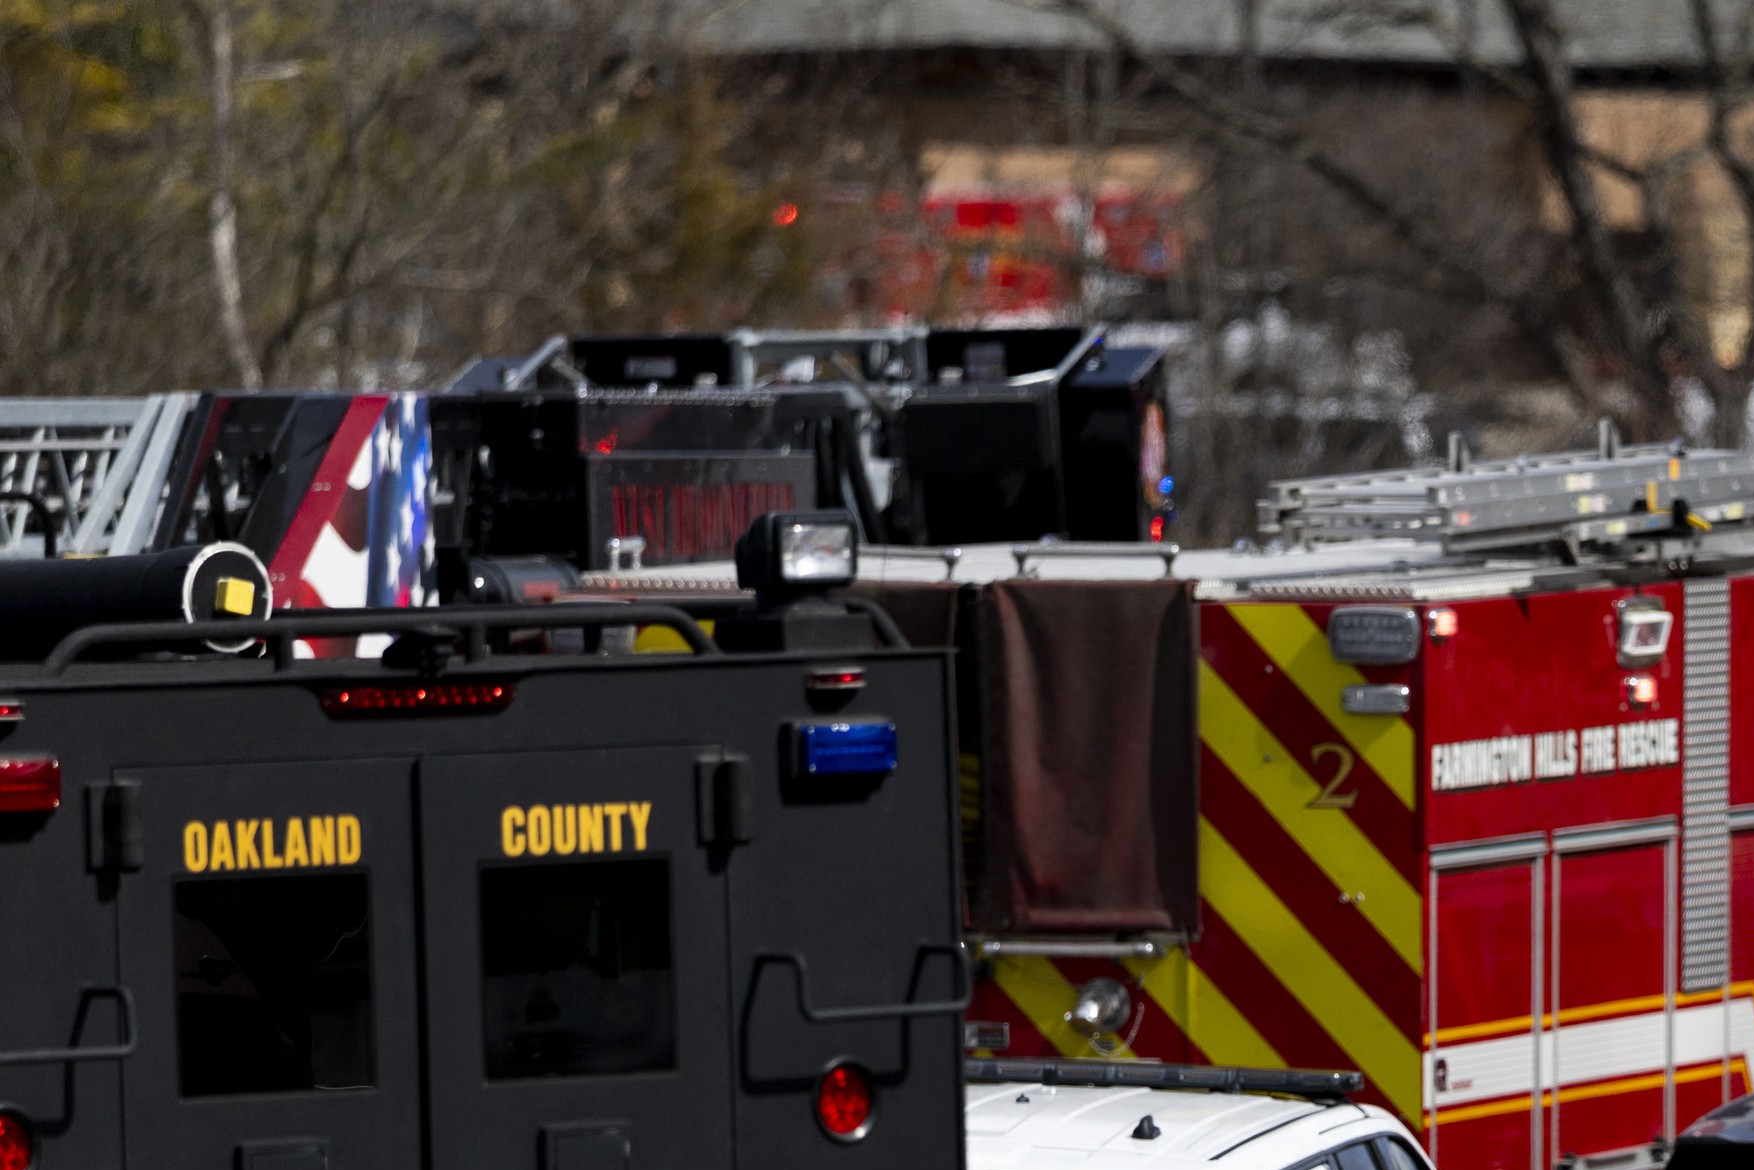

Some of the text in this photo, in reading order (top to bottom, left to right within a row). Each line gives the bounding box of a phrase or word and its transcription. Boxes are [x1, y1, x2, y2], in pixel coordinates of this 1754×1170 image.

[1305, 742, 1359, 809] 2
[1432, 718, 1680, 791] FARMINGTON HILLS FIRE RESCUE
[183, 801, 652, 873] OAKLAND COUNTY
